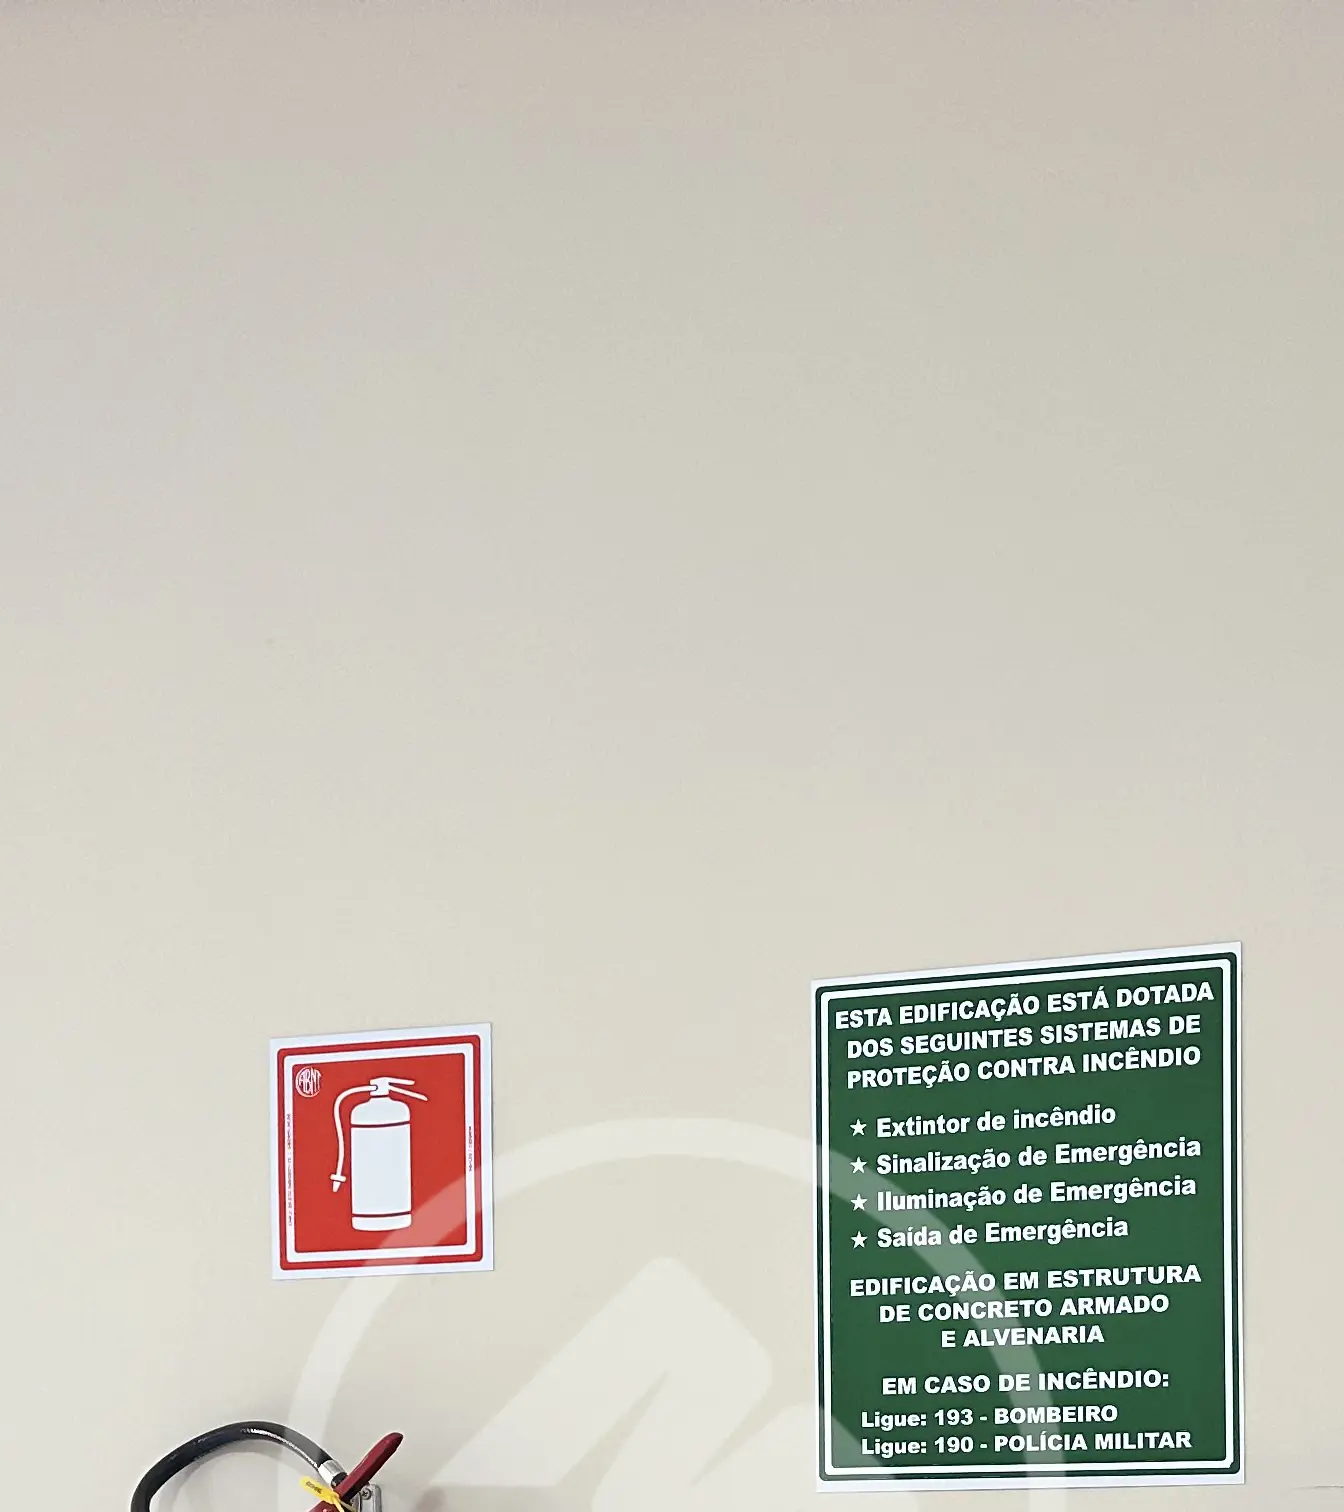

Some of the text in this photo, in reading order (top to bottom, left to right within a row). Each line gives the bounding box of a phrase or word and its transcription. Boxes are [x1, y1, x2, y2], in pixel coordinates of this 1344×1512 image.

[836, 982, 1214, 1029] ESTA EDIFICAÇÃO ESTÁ DOTADA
[848, 1015, 1200, 1058] DOS SEGUINTES SISTEMAS DE
[848, 1047, 1200, 1088] PROTEÇÃO CONTRA INCÊNDIO
[878, 1104, 1115, 1137] Extintor de incêndio
[877, 1137, 1200, 1174] Sinalização de Emergência
[878, 1175, 1195, 1211] Iluminação de Emergência
[878, 1217, 1128, 1247] Saída de Emergência
[851, 1265, 1201, 1296] EDIFICAÇÃO EM ESTRUTURA
[880, 1295, 1168, 1322] DE CONCRETO ARMADO
[942, 1326, 1104, 1347] E ALVENARIA
[883, 1368, 1168, 1394] EM CASO DE INCÊNDIO:
[862, 1412, 926, 1431] Ligue:
[935, 1409, 973, 1425] 193
[995, 1405, 1117, 1424] BOMBEIRO
[862, 1439, 926, 1458] Ligue:
[935, 1437, 973, 1452] 190
[995, 1431, 1087, 1451] POLÍCIA
[1096, 1432, 1191, 1449] MILITAR
